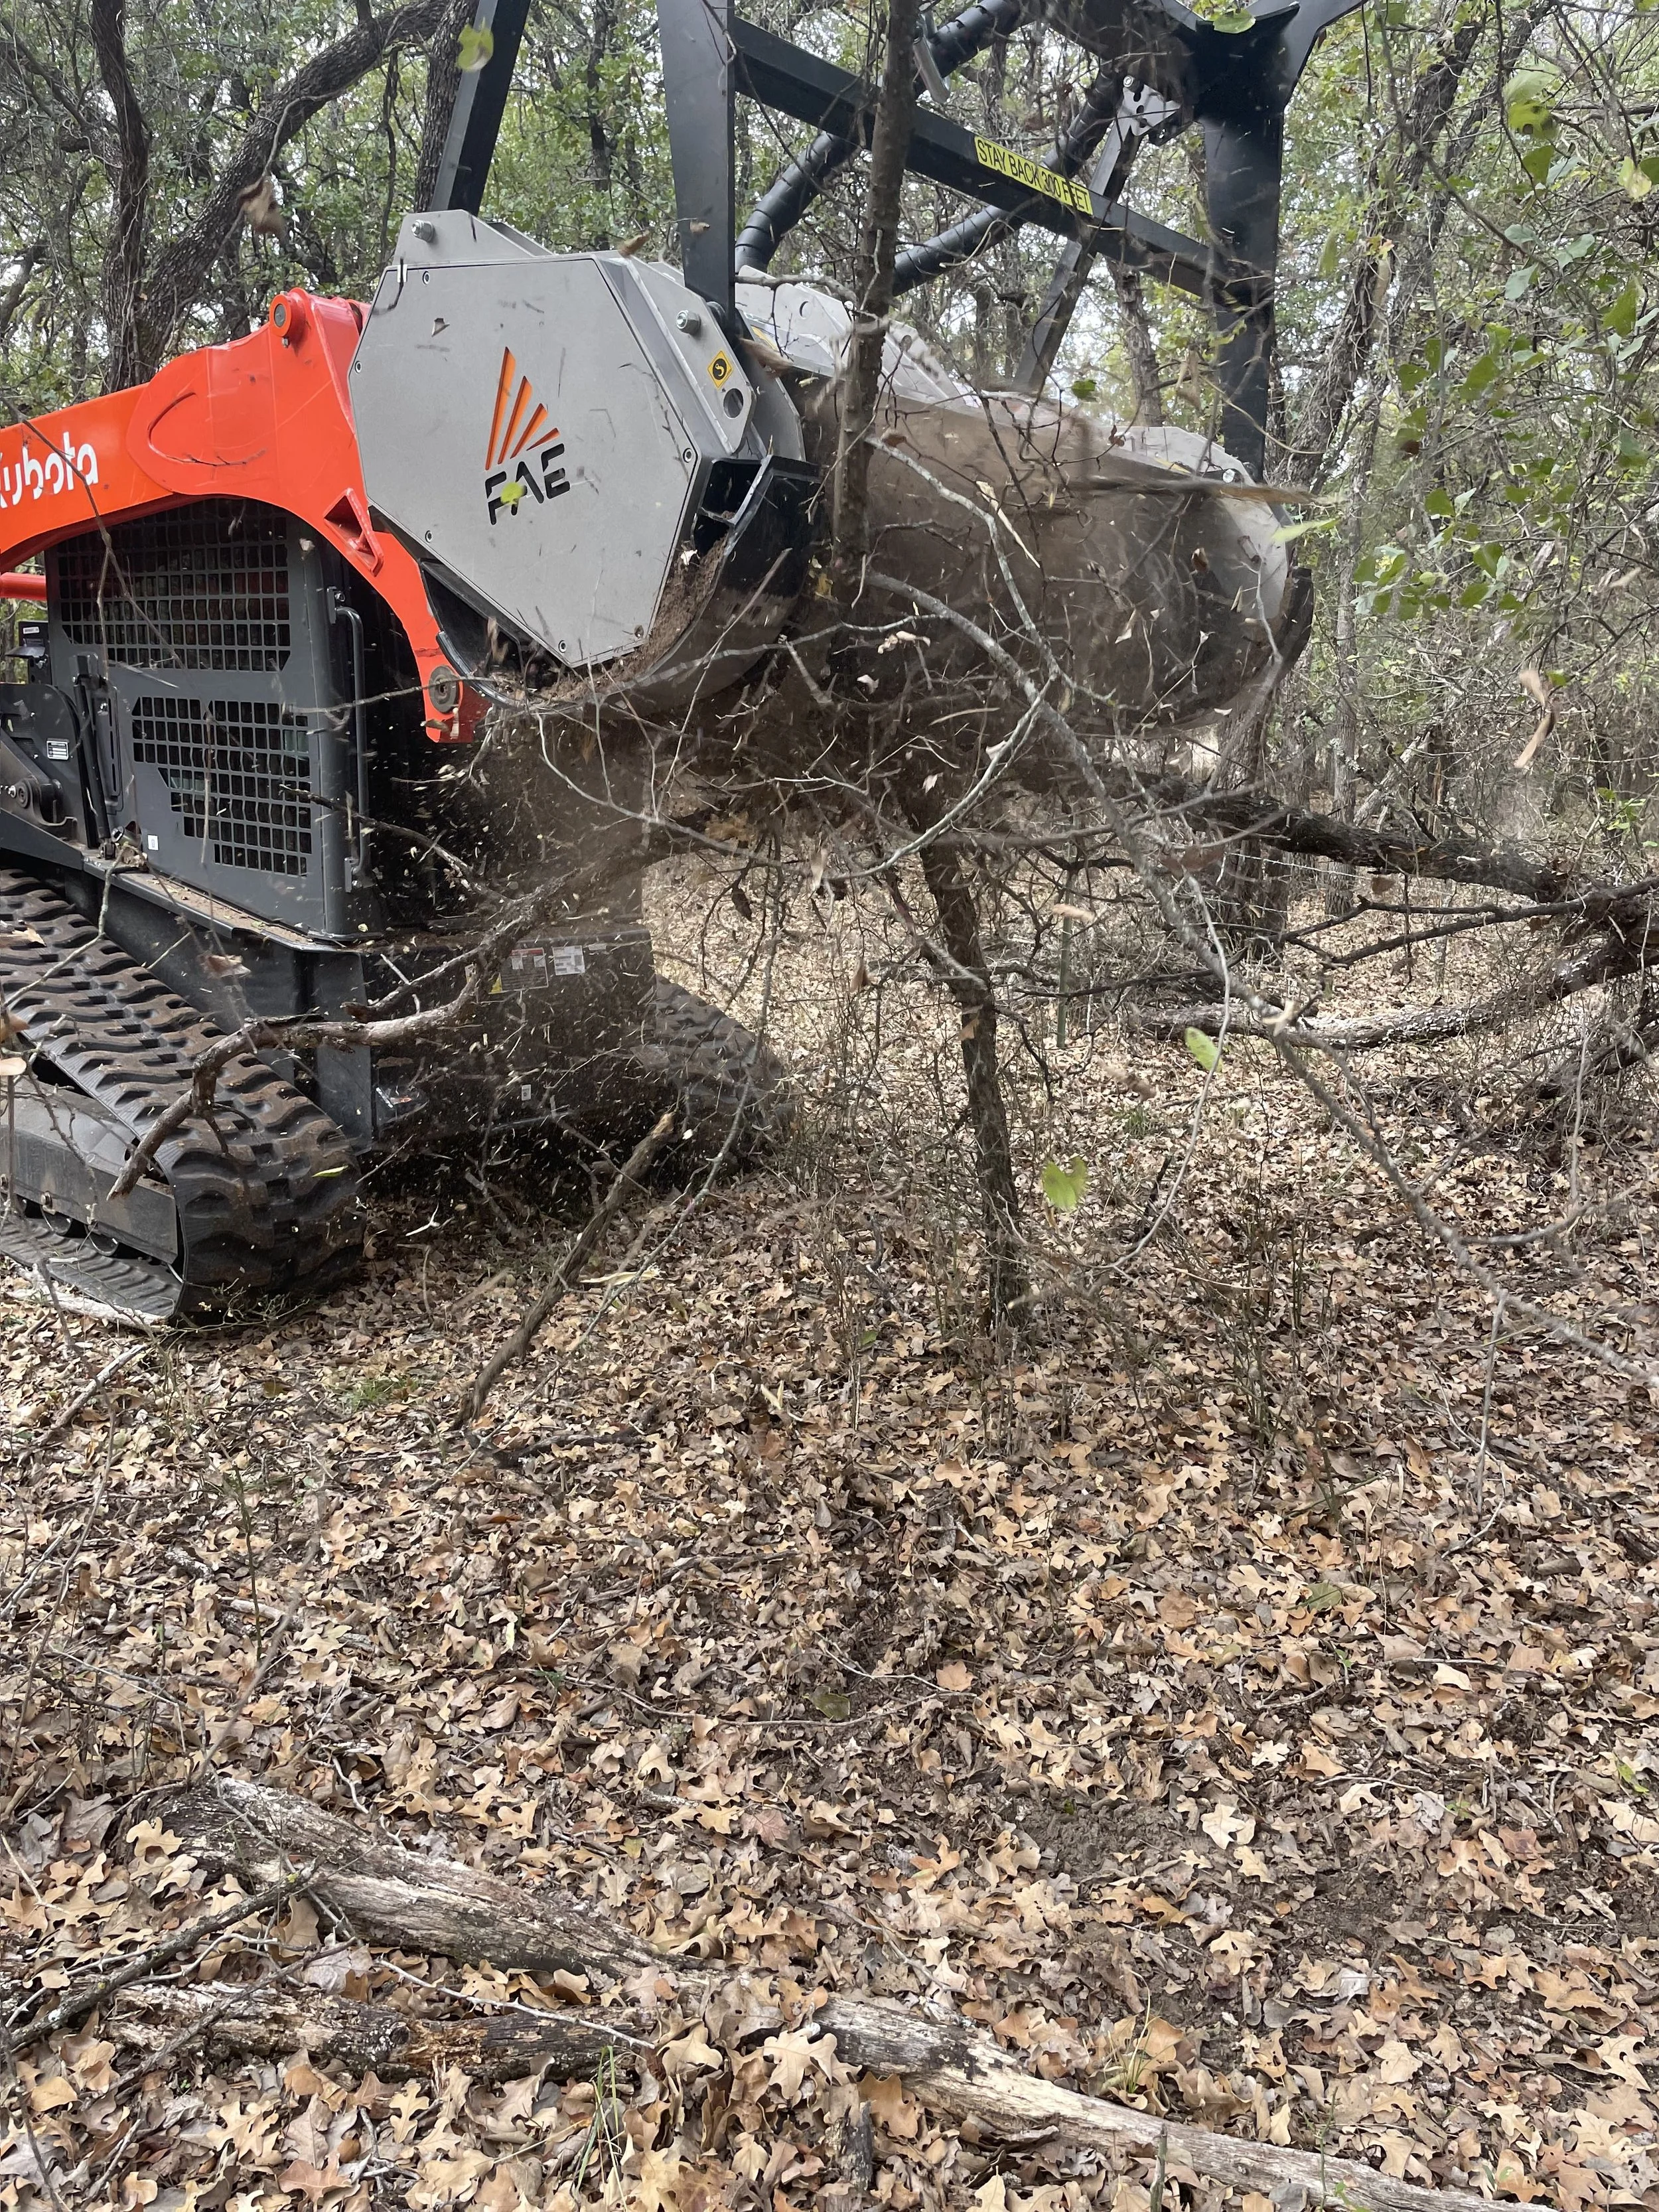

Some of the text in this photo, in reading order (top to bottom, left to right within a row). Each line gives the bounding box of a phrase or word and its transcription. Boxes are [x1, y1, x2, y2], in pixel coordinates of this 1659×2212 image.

[977, 139, 1007, 173] STAY
[1008, 153, 1042, 189] BACK
[1042, 171, 1062, 198] 300
[0, 431, 99, 509] ubota
[485, 443, 571, 526] FAE
